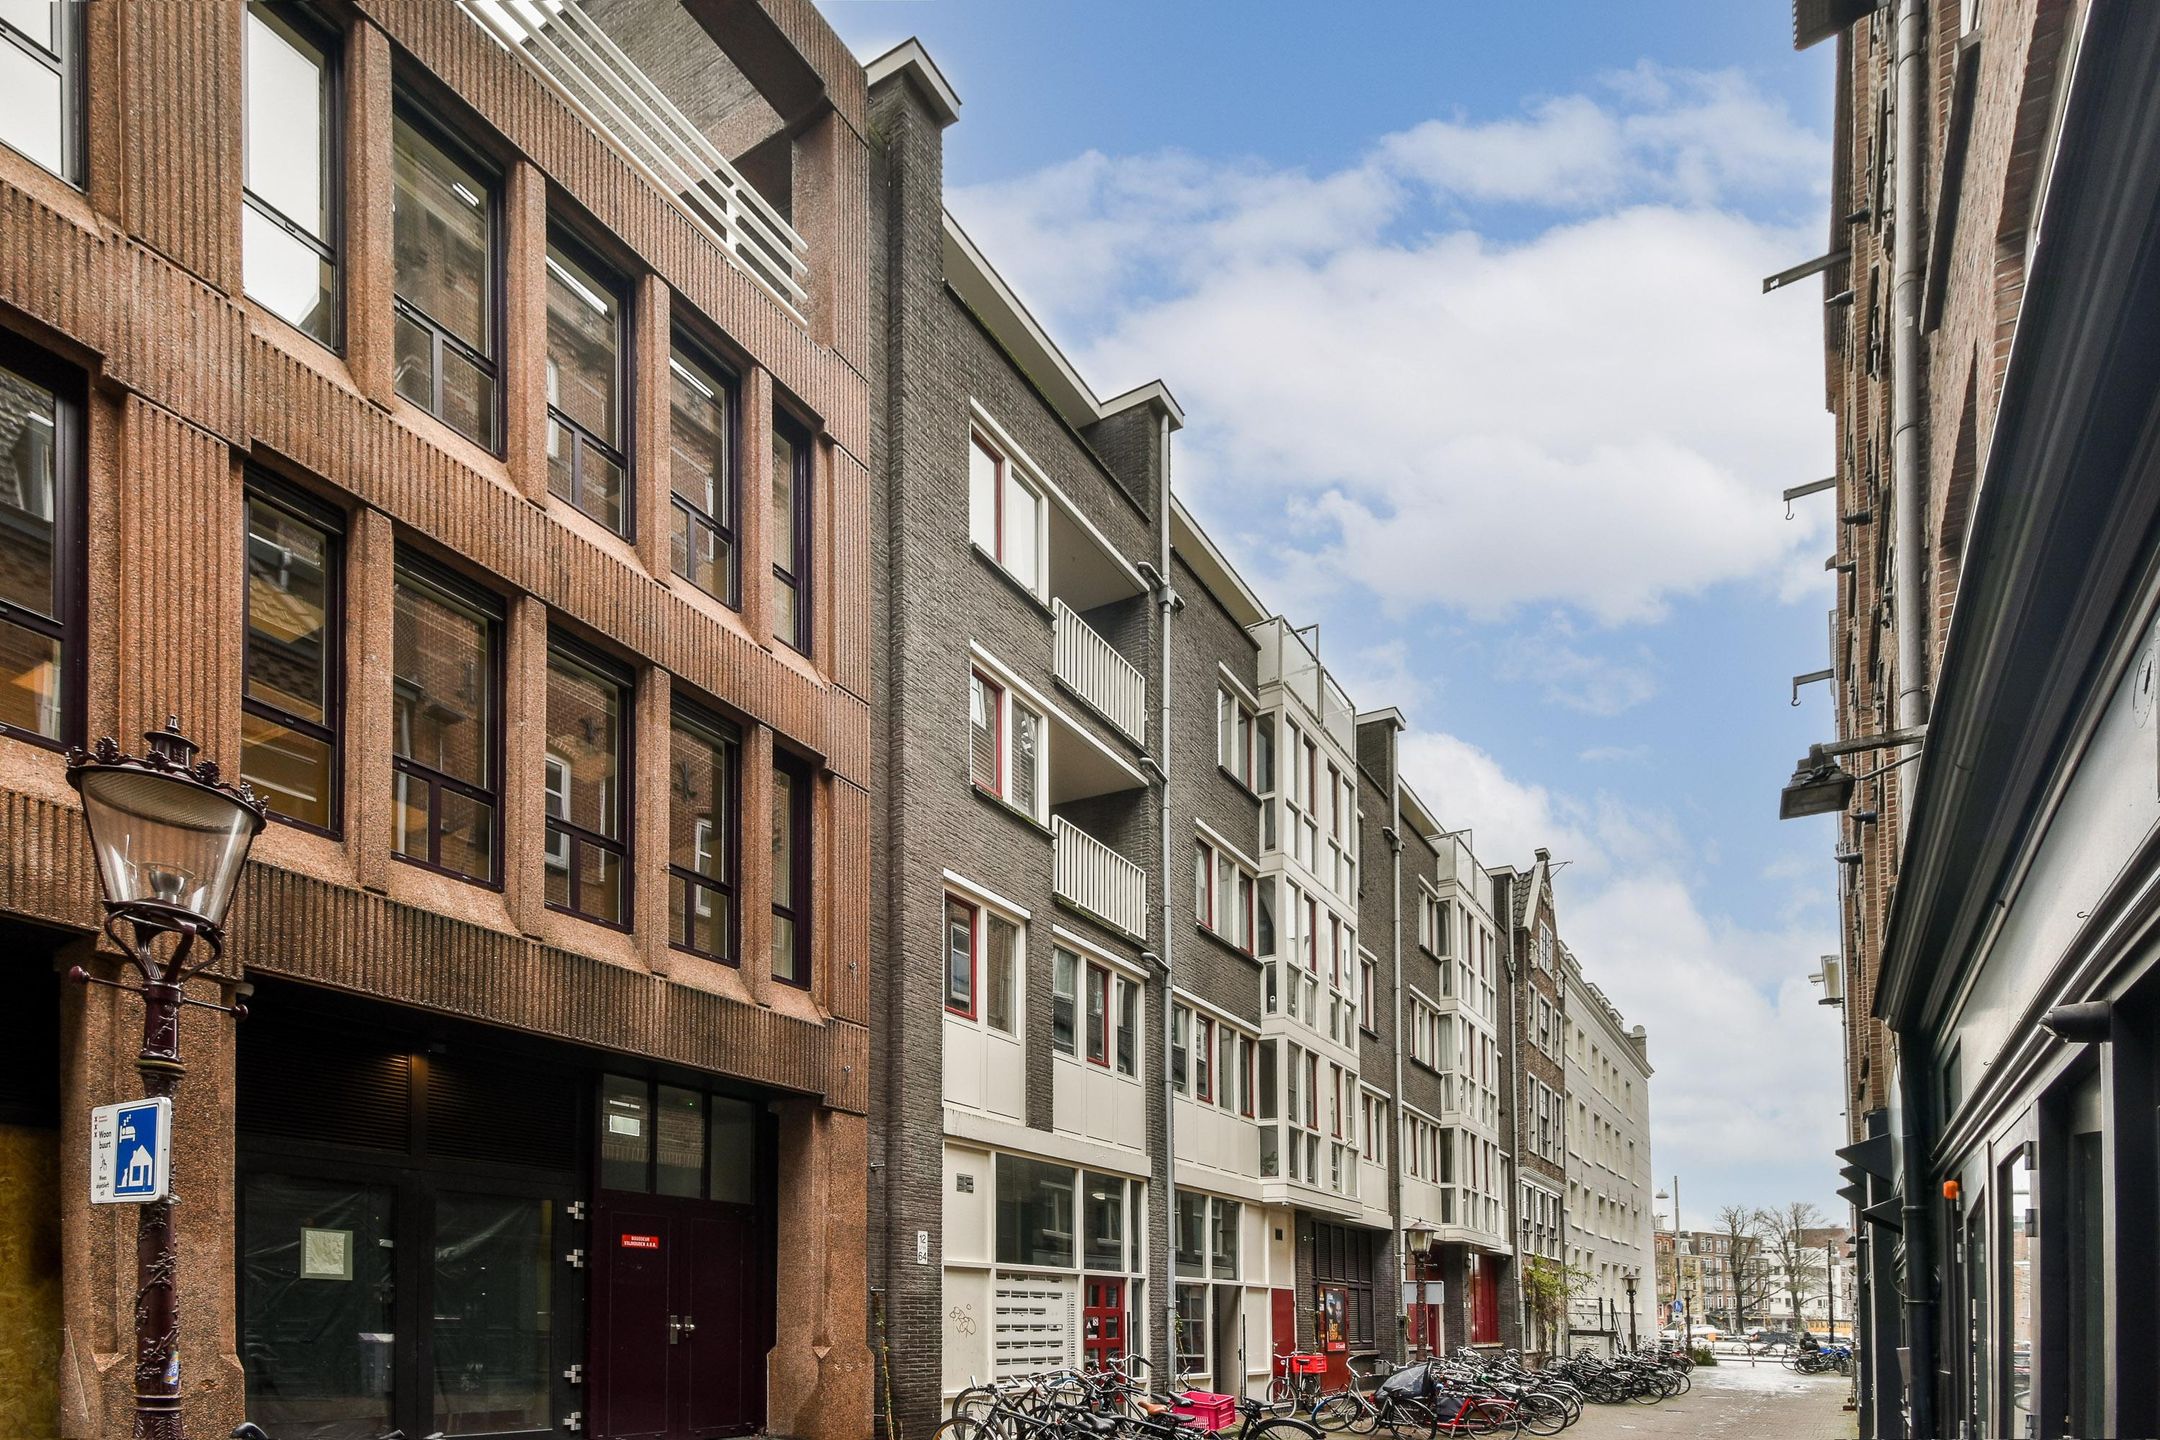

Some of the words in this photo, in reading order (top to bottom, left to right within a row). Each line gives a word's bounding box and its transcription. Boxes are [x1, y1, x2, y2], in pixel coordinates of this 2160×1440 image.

[99, 1130, 112, 1138] Woon
[99, 1140, 111, 1149] buurt
[919, 1234, 926, 1243] 12
[919, 1251, 926, 1261] 64
